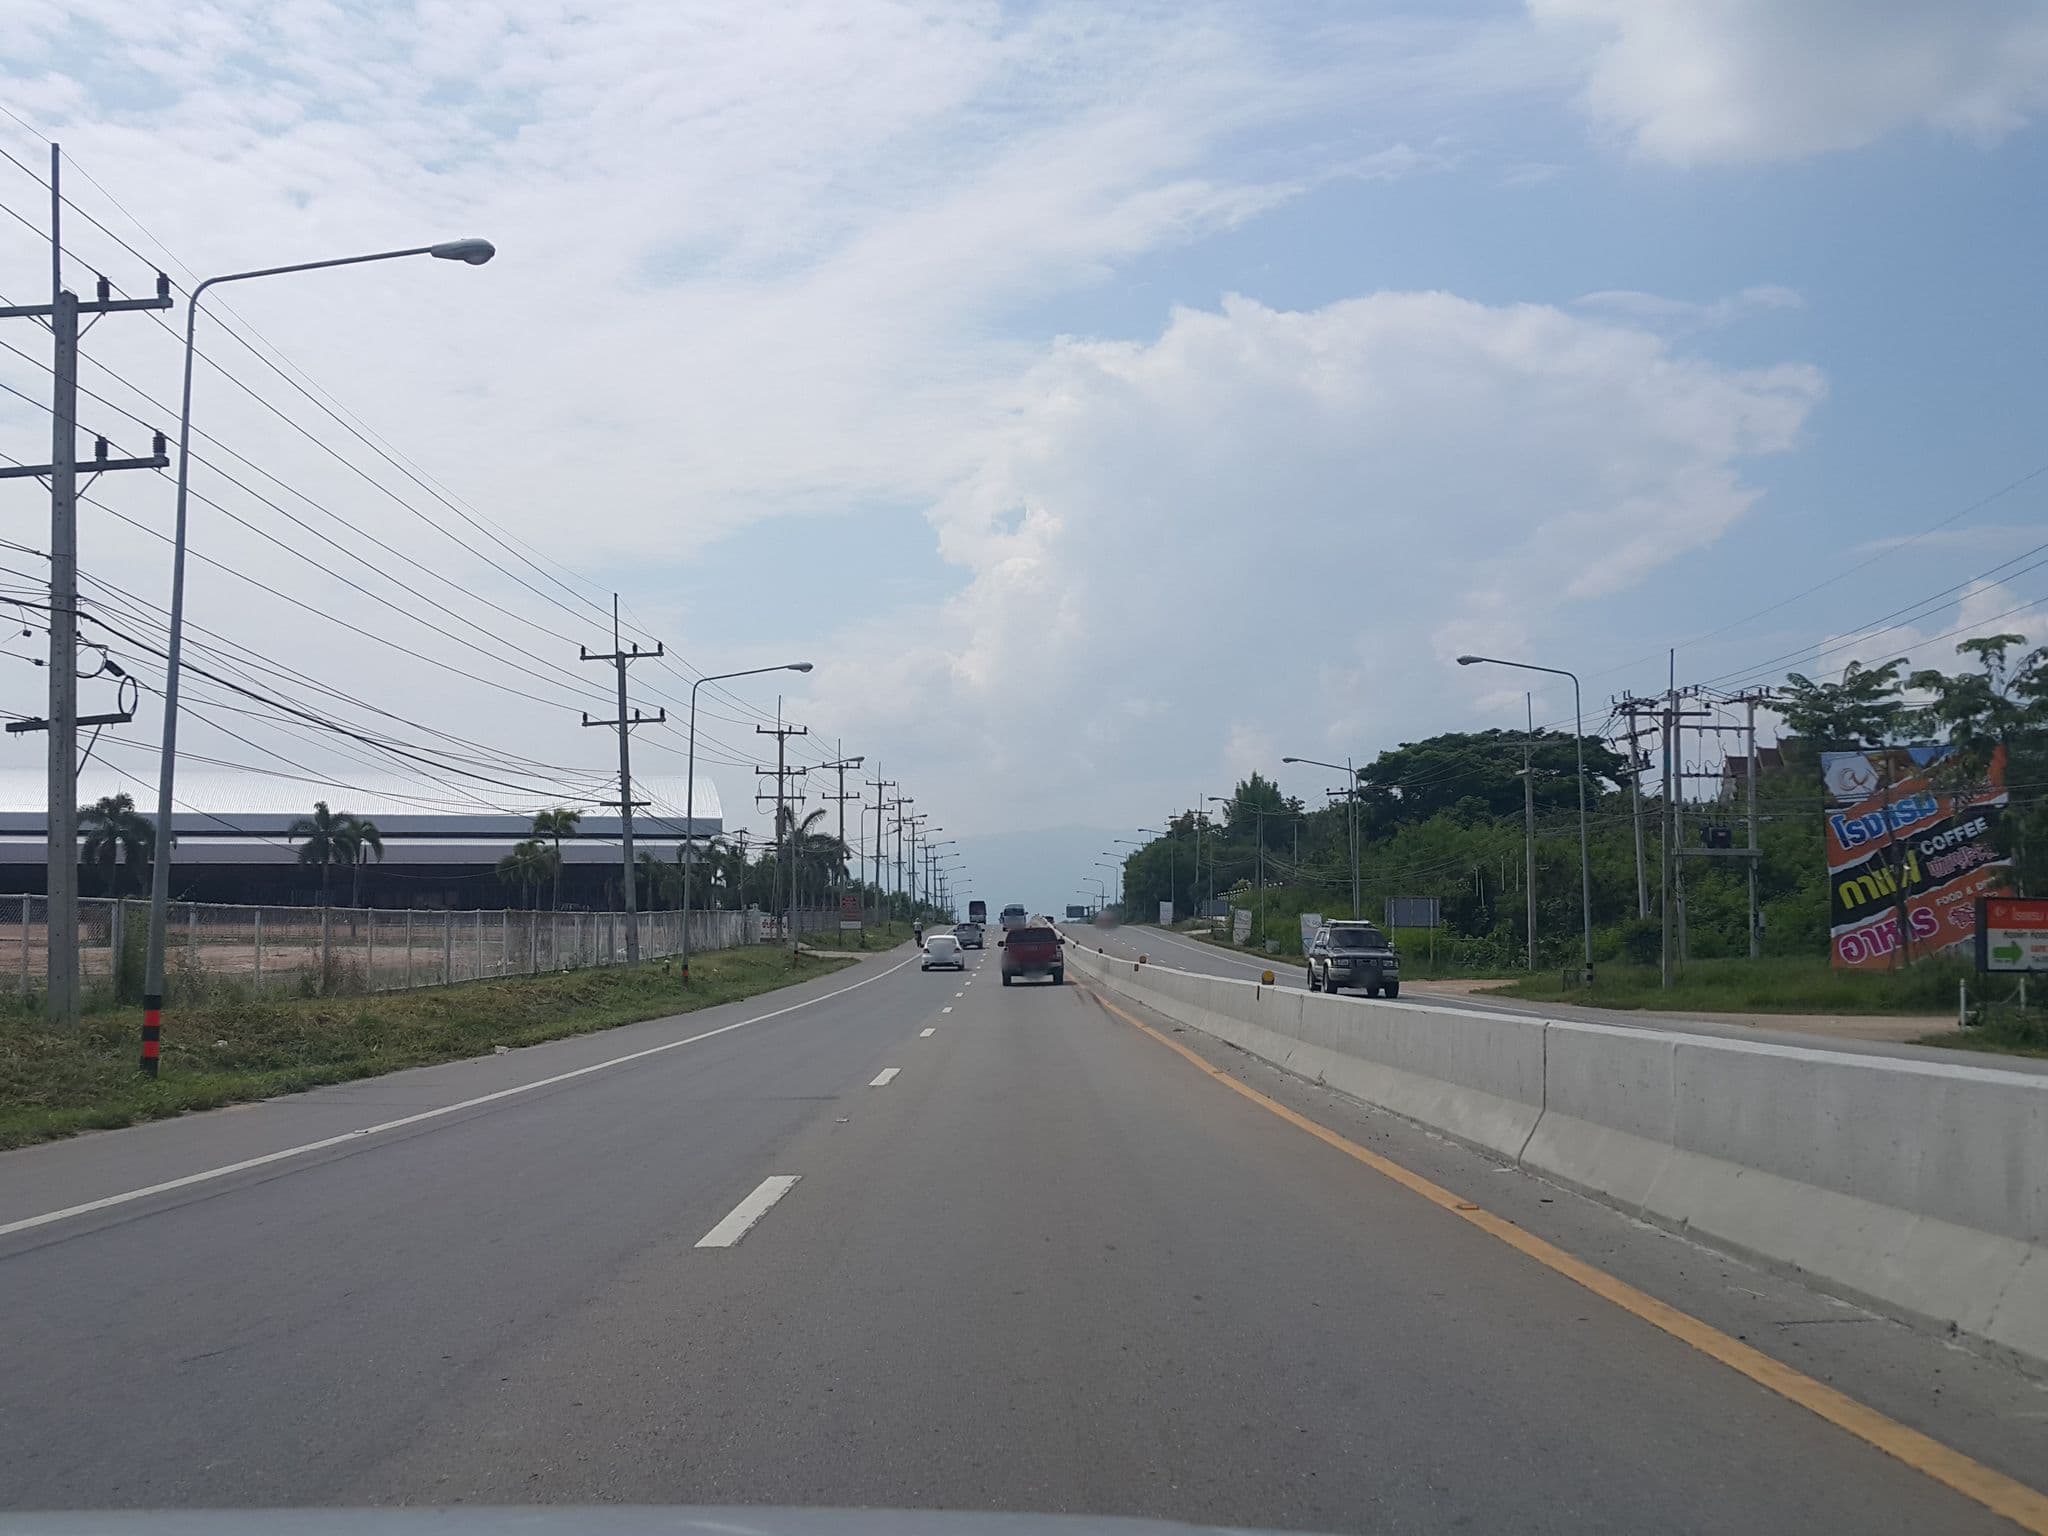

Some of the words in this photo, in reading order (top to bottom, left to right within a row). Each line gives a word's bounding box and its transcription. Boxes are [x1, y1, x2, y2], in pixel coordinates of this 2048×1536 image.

[1920, 816, 1988, 855] COFFEE
[1936, 891, 1963, 906] FOOD
[1839, 906, 1940, 964] อาหร
